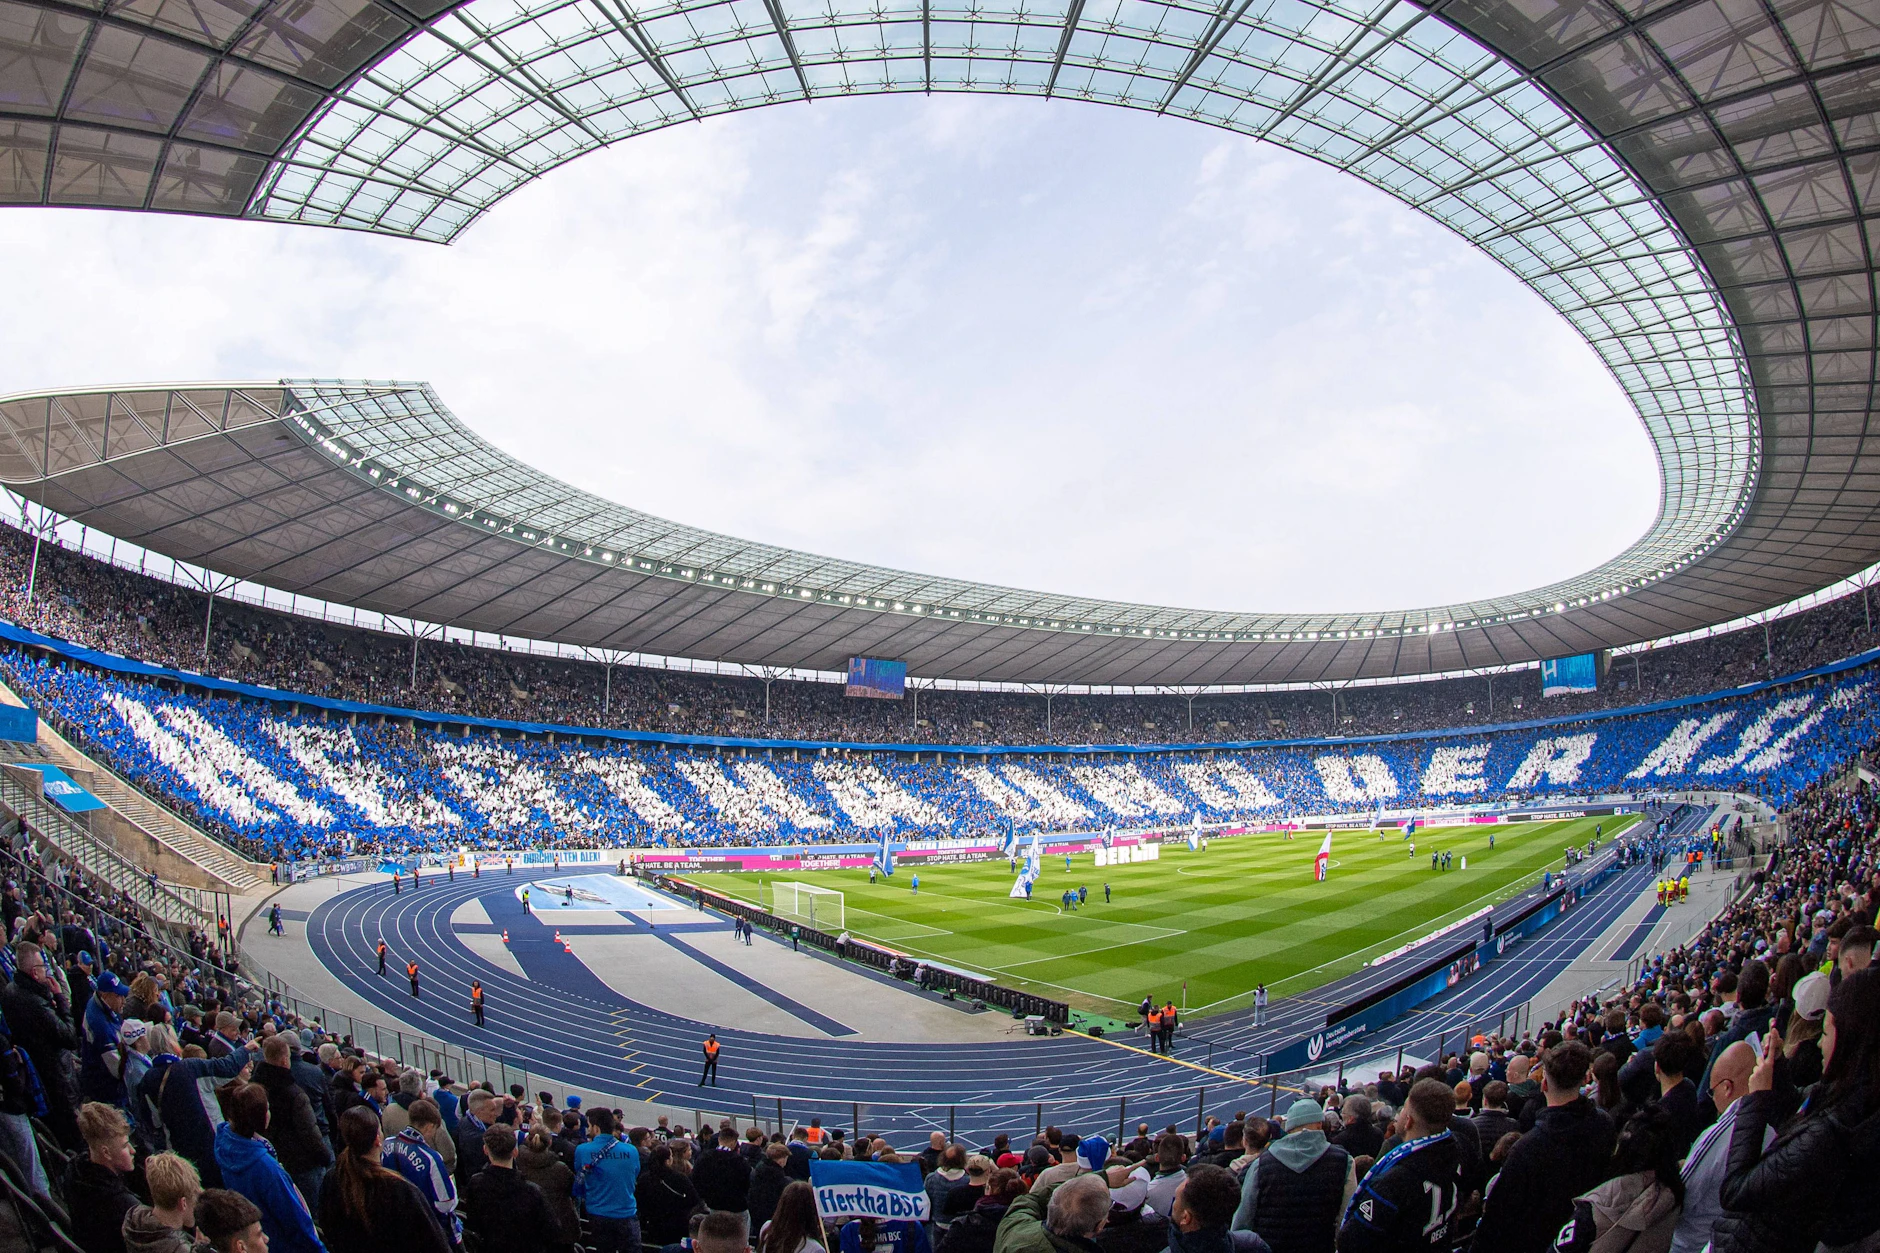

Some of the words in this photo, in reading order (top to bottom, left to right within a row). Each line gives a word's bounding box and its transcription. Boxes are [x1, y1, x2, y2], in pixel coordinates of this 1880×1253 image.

[580, 851, 600, 862] ALEX!
[645, 861, 662, 869] HATE.
[664, 861, 673, 869] BE
[680, 861, 702, 869] TEAM.
[800, 860, 840, 868] TOGETHER!
[590, 1151, 630, 1160] BRLIN
[407, 1151, 426, 1172] BSC
[887, 1230, 901, 1242] BSC
